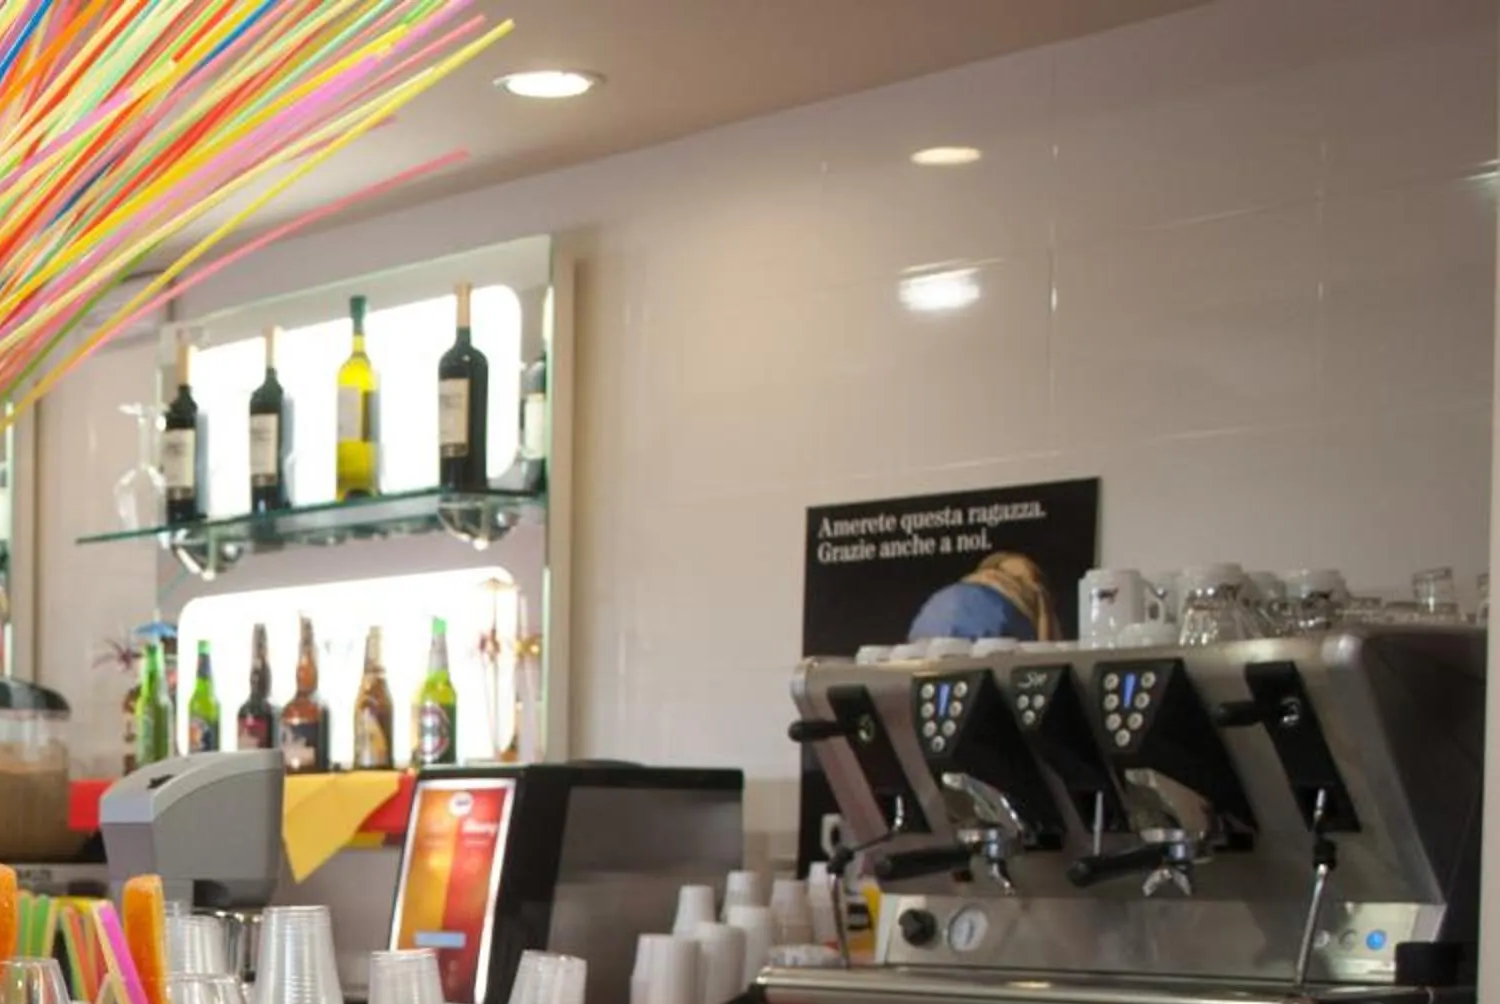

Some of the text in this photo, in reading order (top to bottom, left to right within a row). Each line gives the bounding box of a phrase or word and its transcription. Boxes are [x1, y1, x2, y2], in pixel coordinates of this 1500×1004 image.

[818, 501, 1046, 538] Amerete questa ragazza.
[817, 527, 992, 563] Grazie anche a noi.
